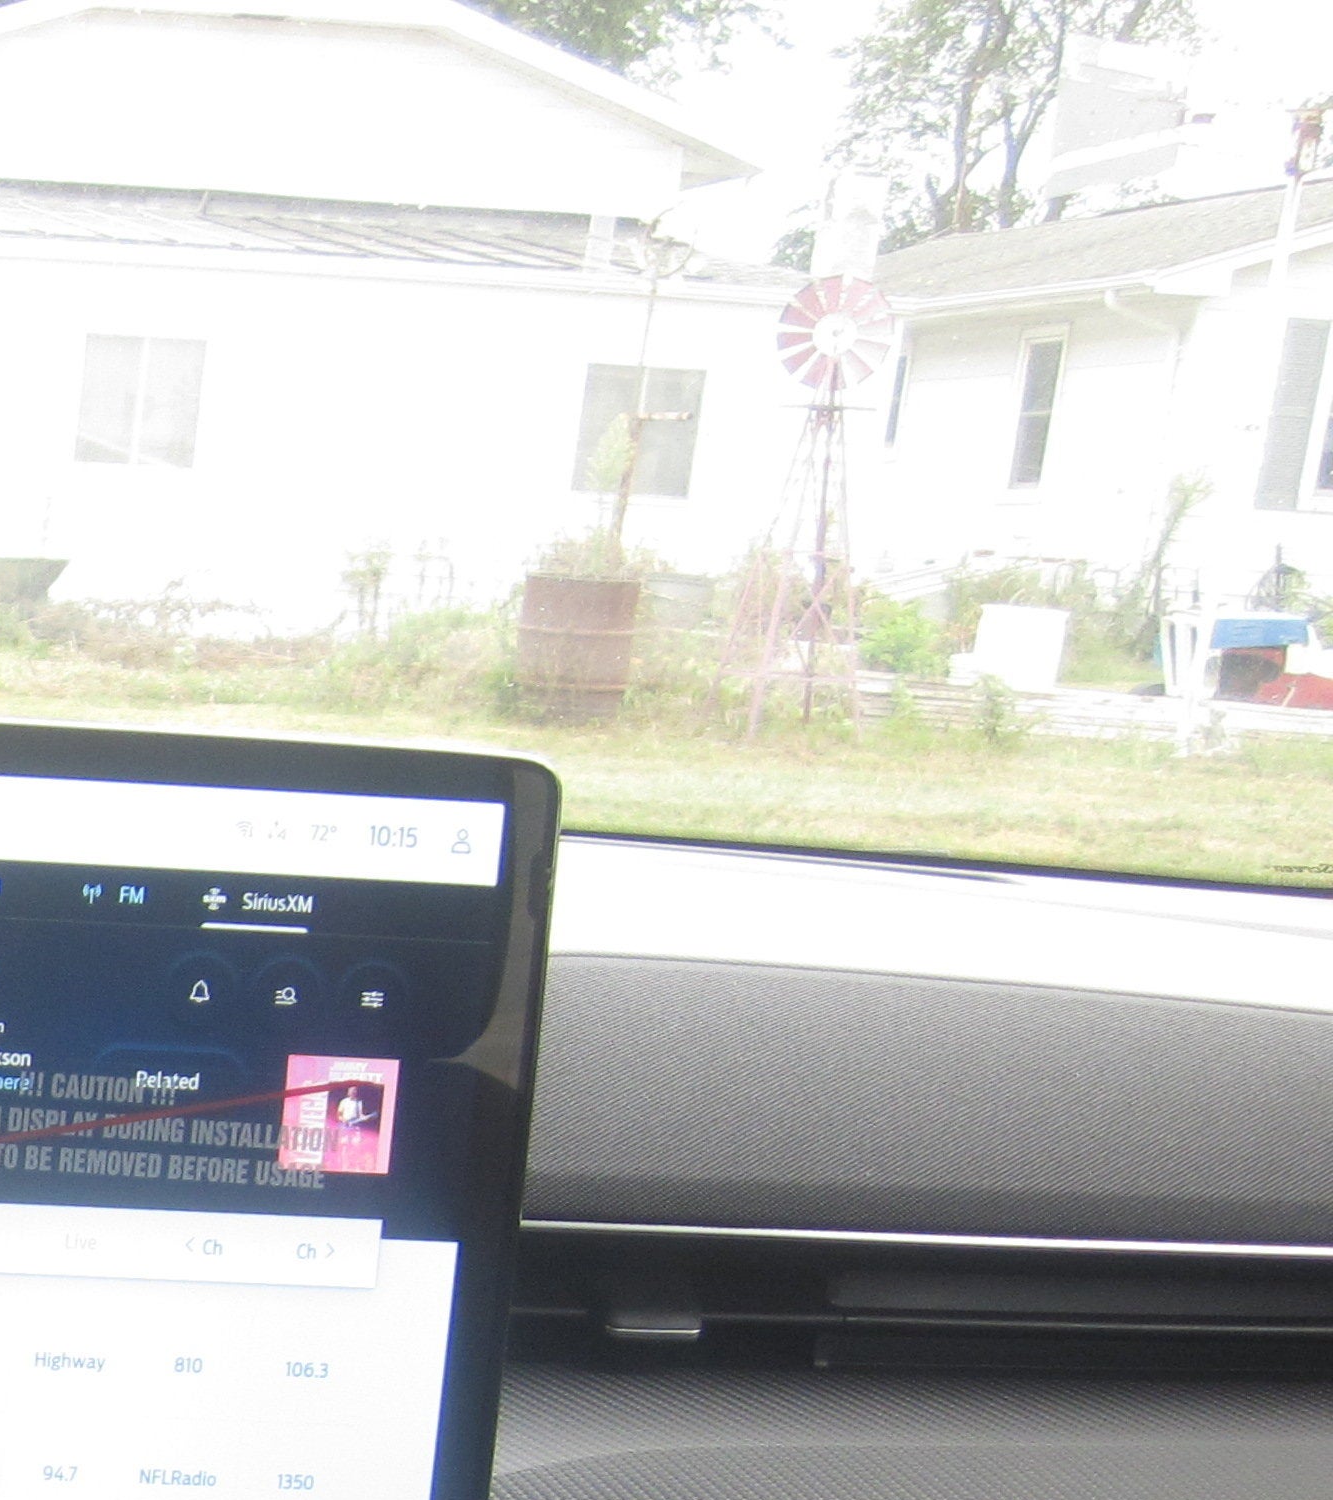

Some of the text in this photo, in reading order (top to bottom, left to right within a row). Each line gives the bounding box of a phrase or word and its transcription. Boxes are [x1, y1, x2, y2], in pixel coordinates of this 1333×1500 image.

[368, 825, 419, 849] 10:15
[118, 884, 145, 905] FM
[241, 890, 314, 914] SiriusXM
[50, 1071, 144, 1104] CAUTION
[135, 1070, 201, 1091] Related
[8, 1106, 98, 1138] DISPLAY
[102, 1112, 185, 1143] DURING
[190, 1118, 341, 1153] INSTALLATION
[23, 1145, 53, 1171] BE
[59, 1146, 162, 1179] REMOVED
[167, 1153, 248, 1185] BEFORE
[255, 1160, 325, 1189] USAGE
[64, 1233, 97, 1251] Live
[202, 1239, 223, 1255] Ch
[296, 1243, 317, 1260] Ch
[34, 1352, 106, 1373] Highway
[174, 1357, 203, 1374] 810
[285, 1361, 329, 1379] 106.3
[42, 1465, 78, 1483] 94.7
[277, 1473, 315, 1490] 1350
